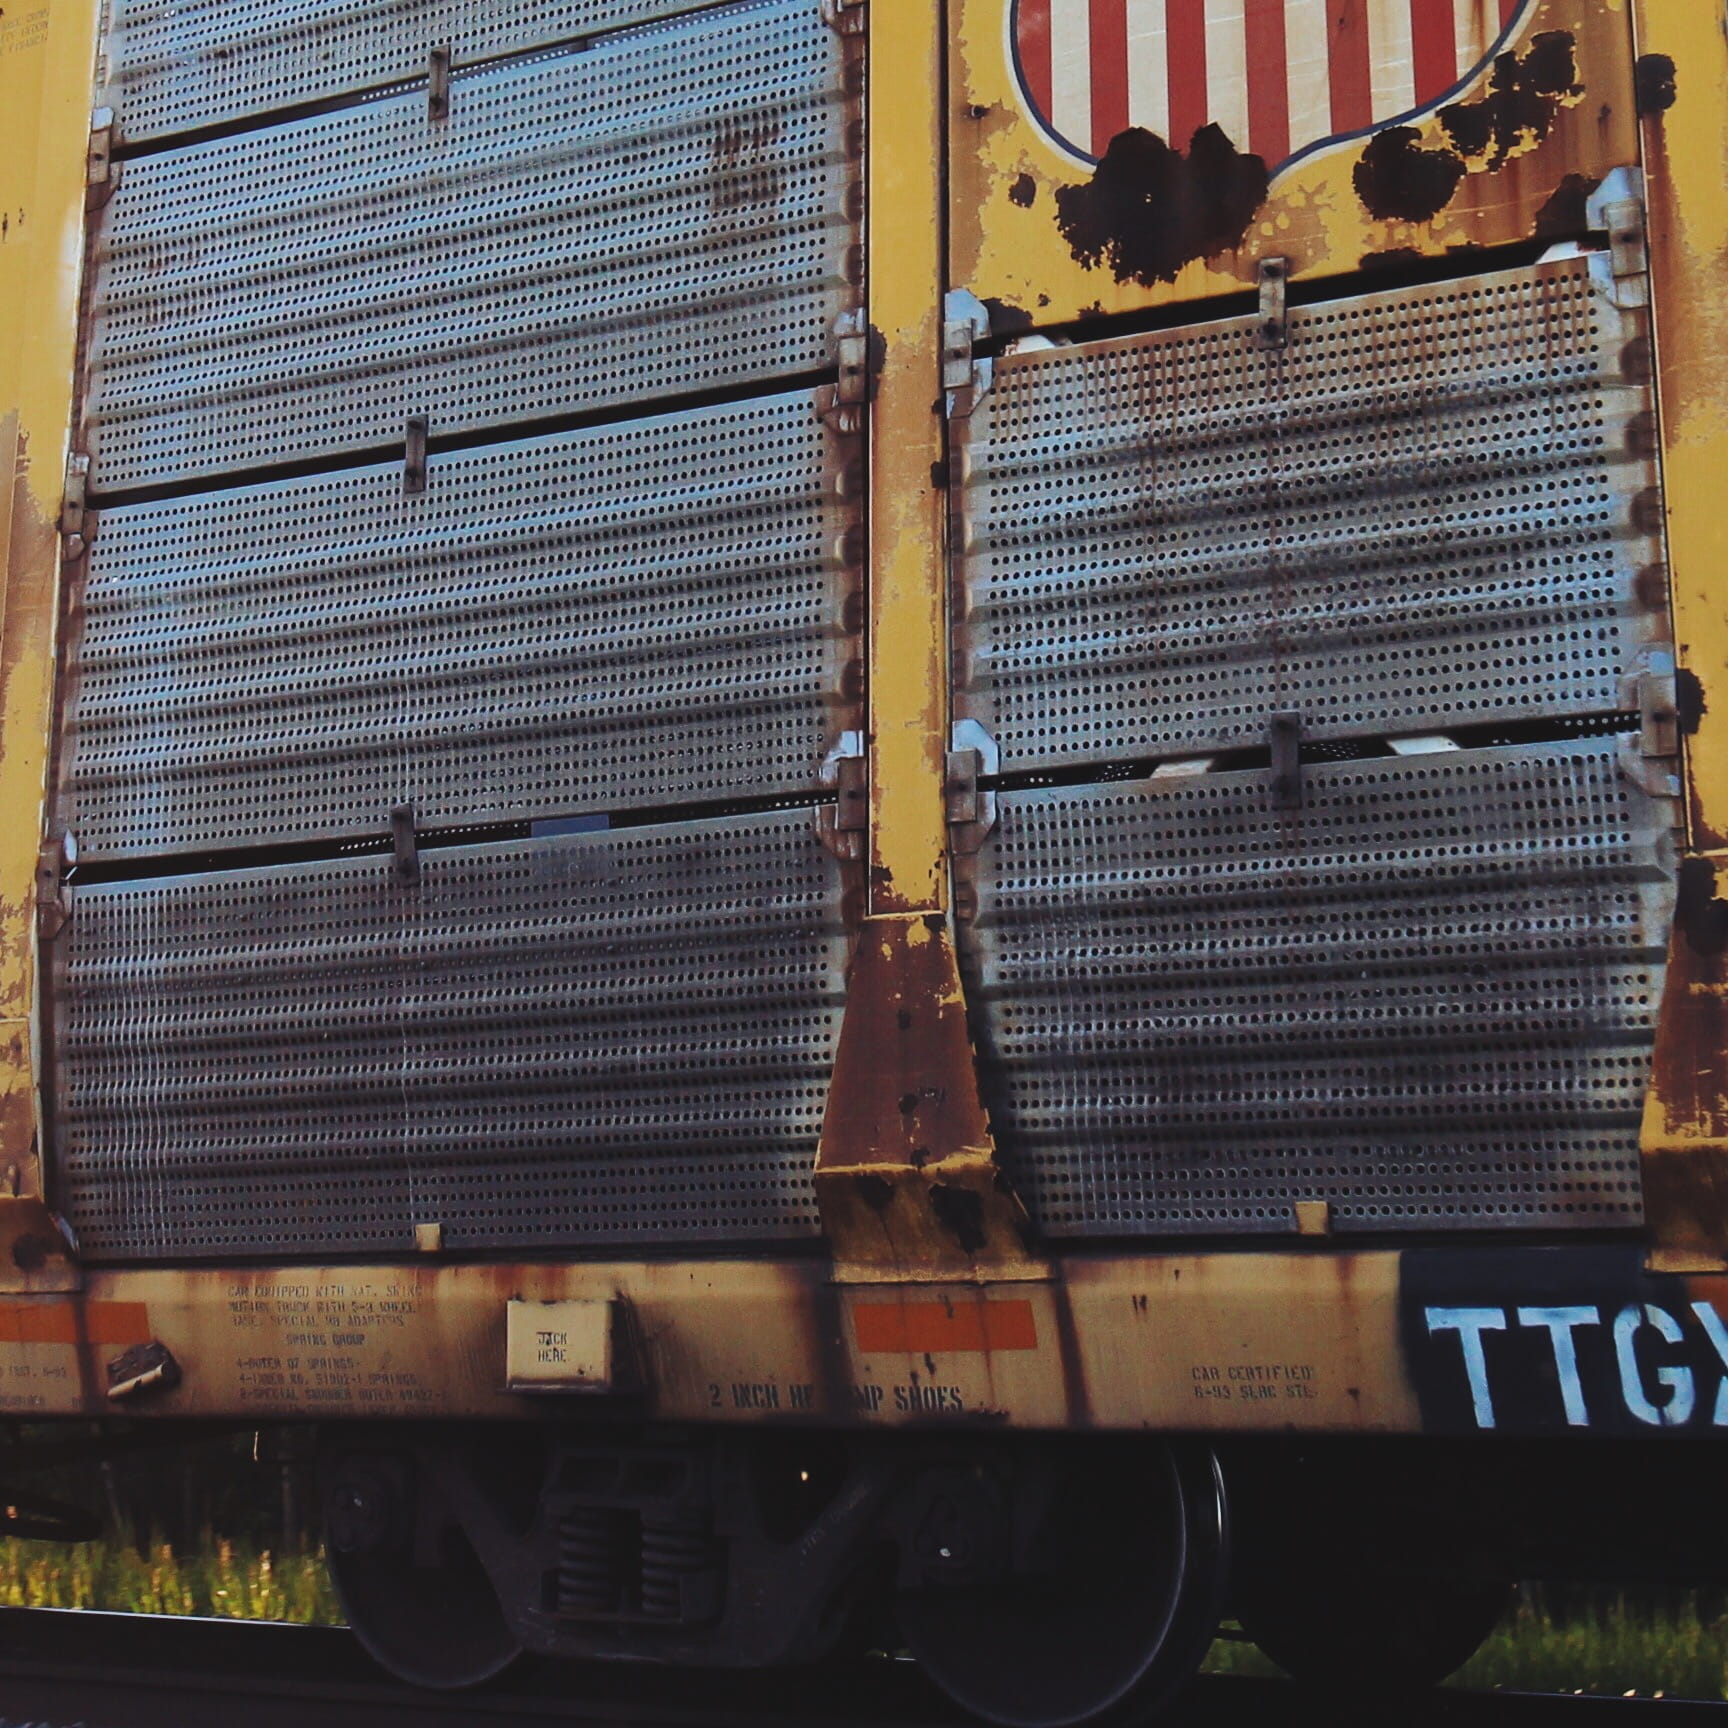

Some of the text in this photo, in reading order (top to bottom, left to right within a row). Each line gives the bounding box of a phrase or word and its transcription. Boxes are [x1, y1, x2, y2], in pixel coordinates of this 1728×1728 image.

[537, 1332, 568, 1363] JACK HERE
[1191, 1365, 1314, 1381] CAR CERTIFIED
[708, 1384, 722, 1408] 2
[731, 1383, 781, 1409] INCH
[892, 1385, 964, 1412] SHOES
